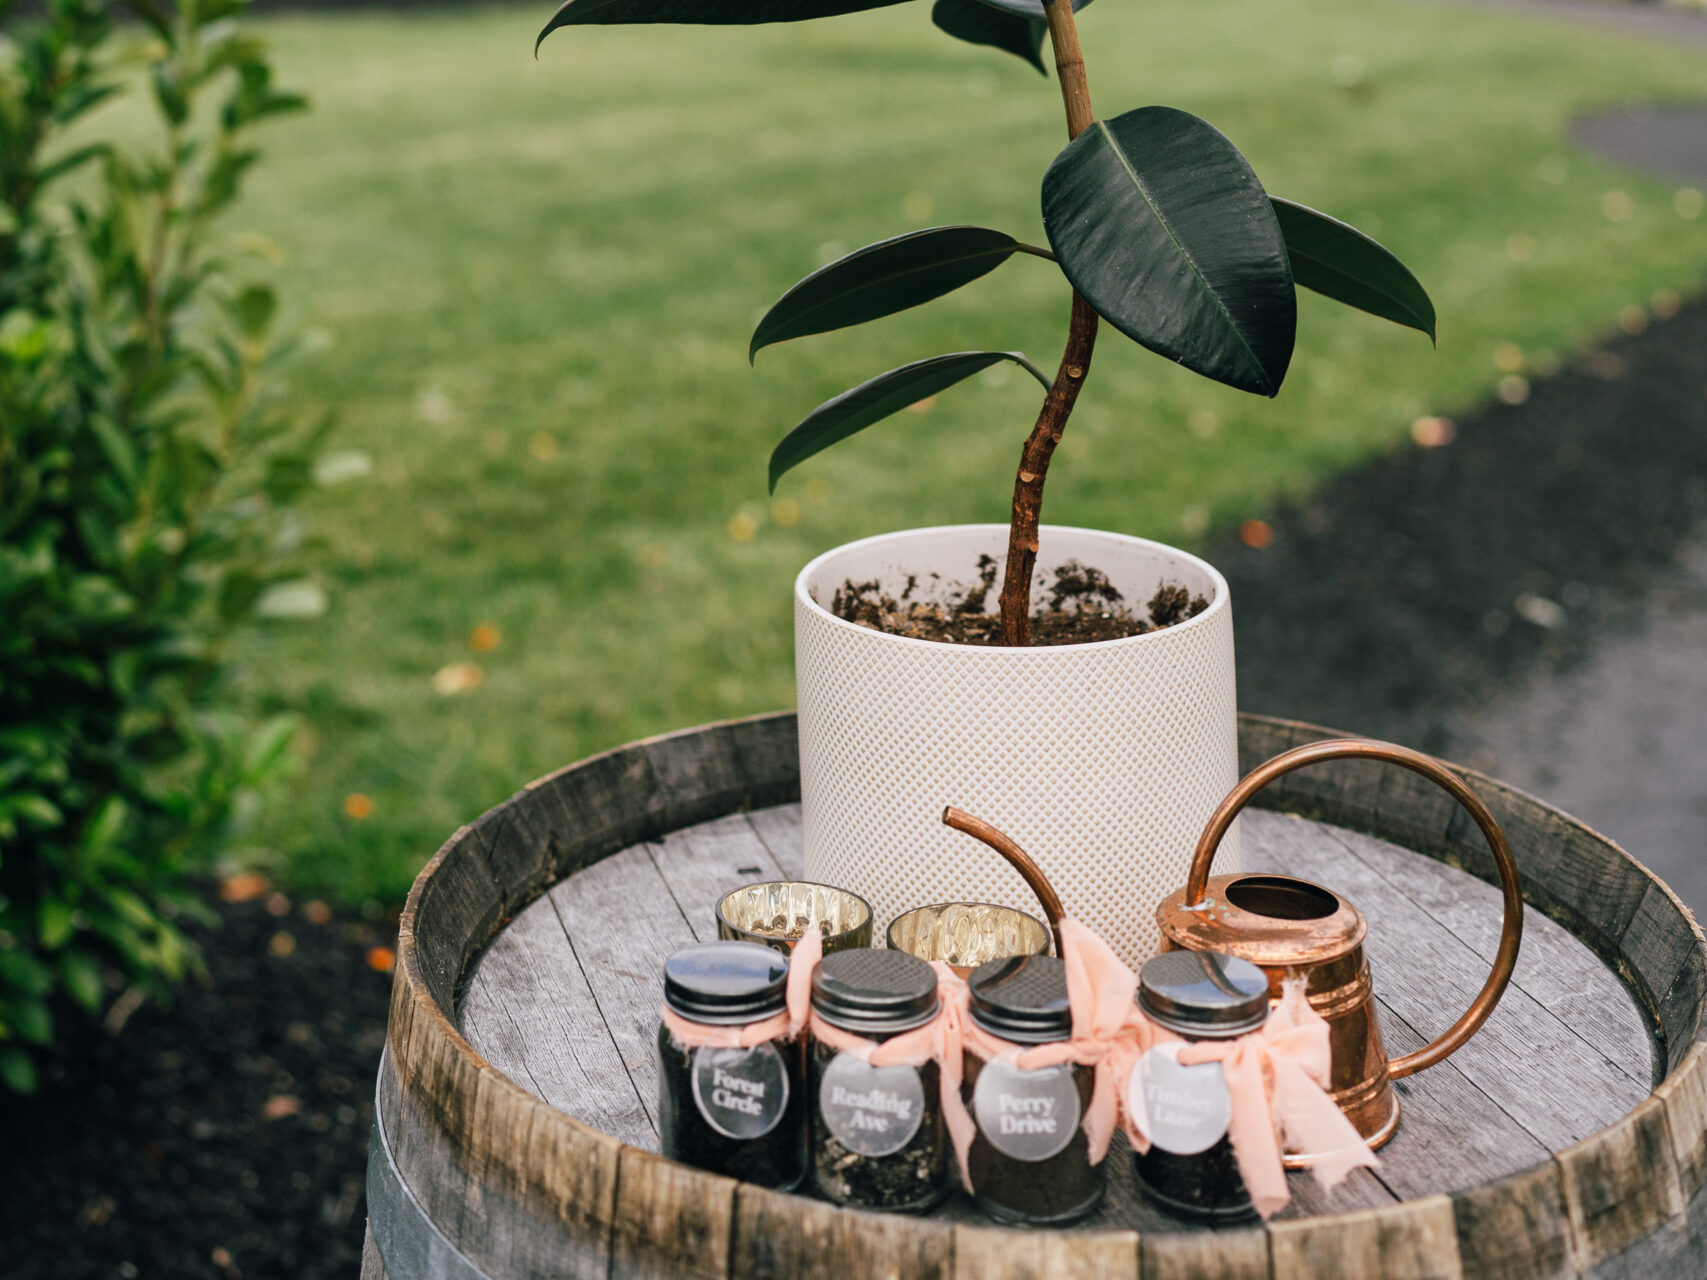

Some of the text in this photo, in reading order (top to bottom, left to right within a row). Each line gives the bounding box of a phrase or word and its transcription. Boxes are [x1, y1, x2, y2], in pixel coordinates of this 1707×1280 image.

[710, 1067, 764, 1097] Forest
[712, 1088, 762, 1116] Circle
[831, 1086, 911, 1119] Reading
[999, 1093, 1055, 1117] Perry
[851, 1110, 888, 1132] Ave
[1001, 1114, 1057, 1135] Drive
